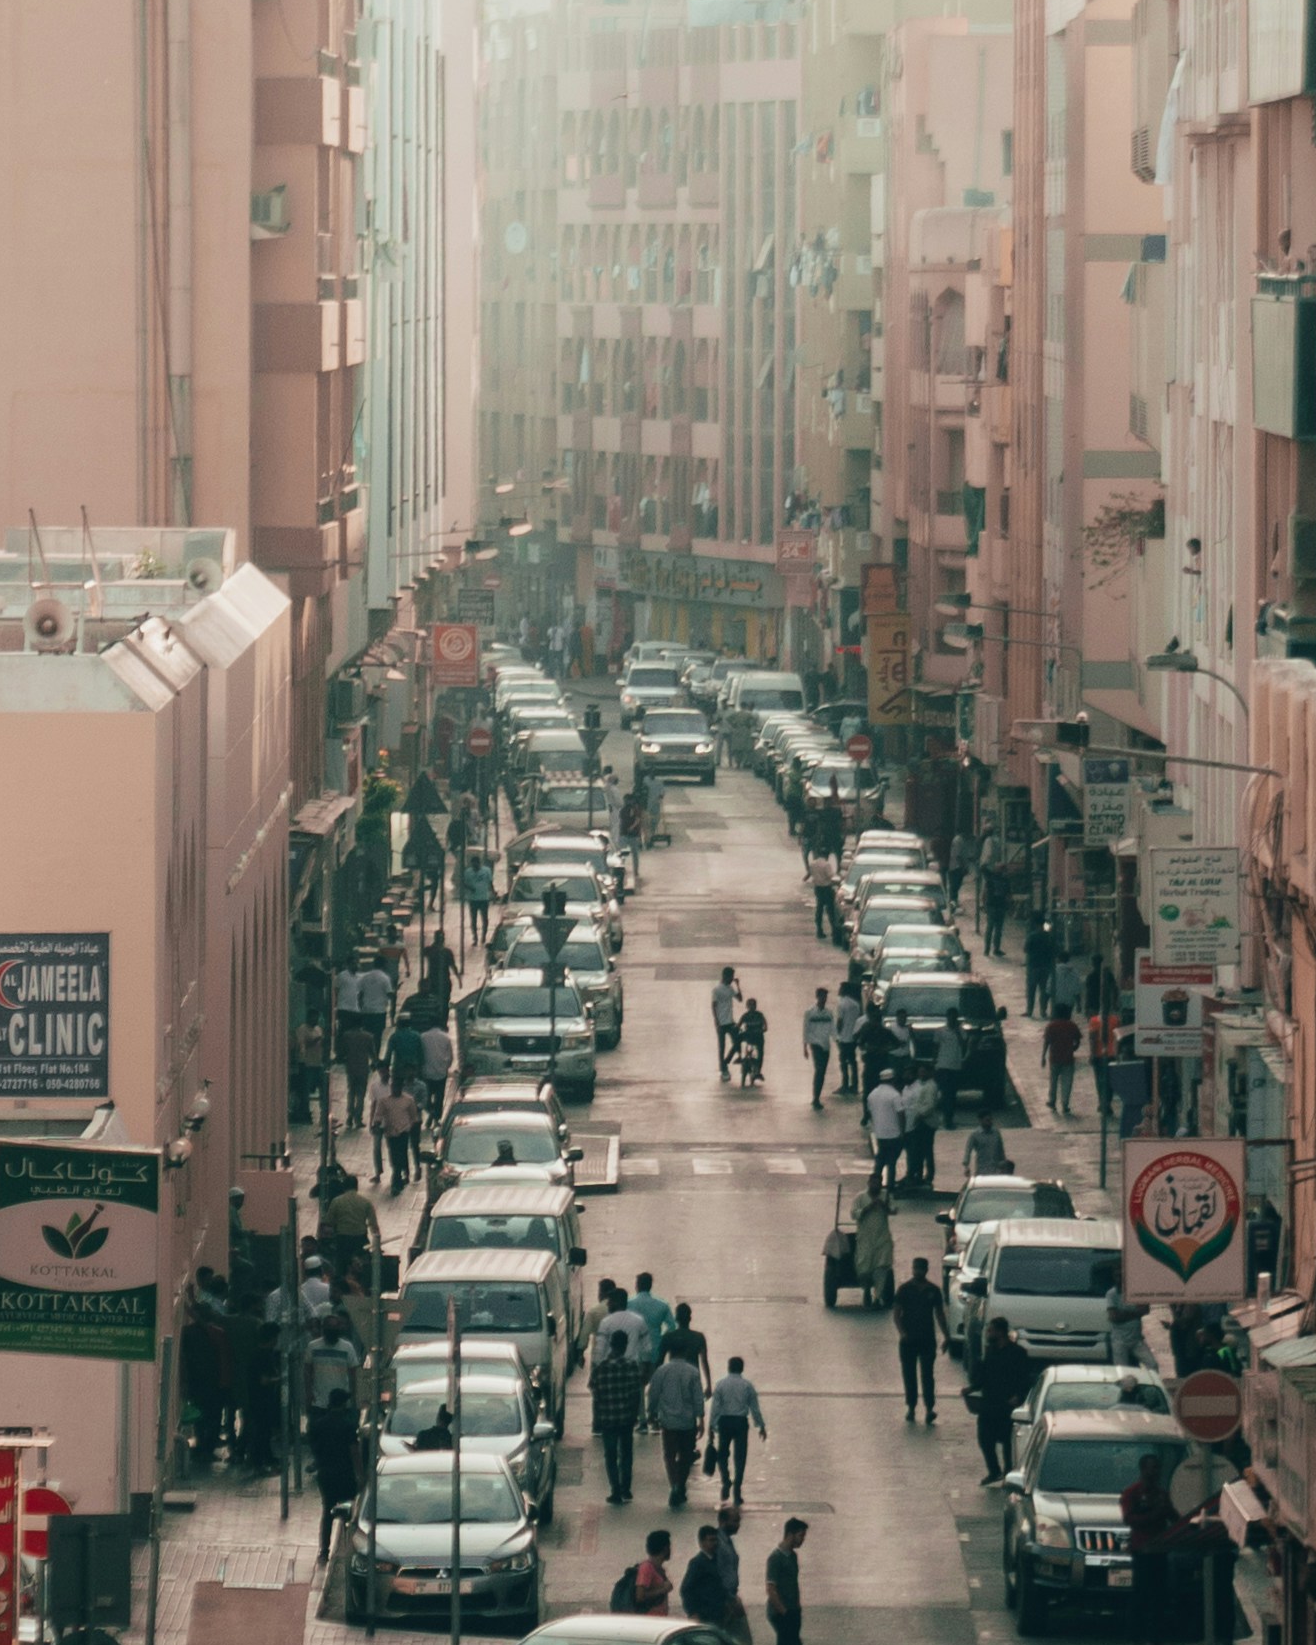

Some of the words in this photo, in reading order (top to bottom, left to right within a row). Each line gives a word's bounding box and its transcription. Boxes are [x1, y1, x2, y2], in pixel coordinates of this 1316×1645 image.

[4, 974, 17, 986] AL
[17, 965, 101, 1002] JAMEELA
[8, 1013, 103, 1055] CLINIC
[40, 1064, 57, 1074] Flat
[29, 1265, 117, 1279] KOTTAKKAL
[0, 1291, 146, 1315] KOTTAKKAL
